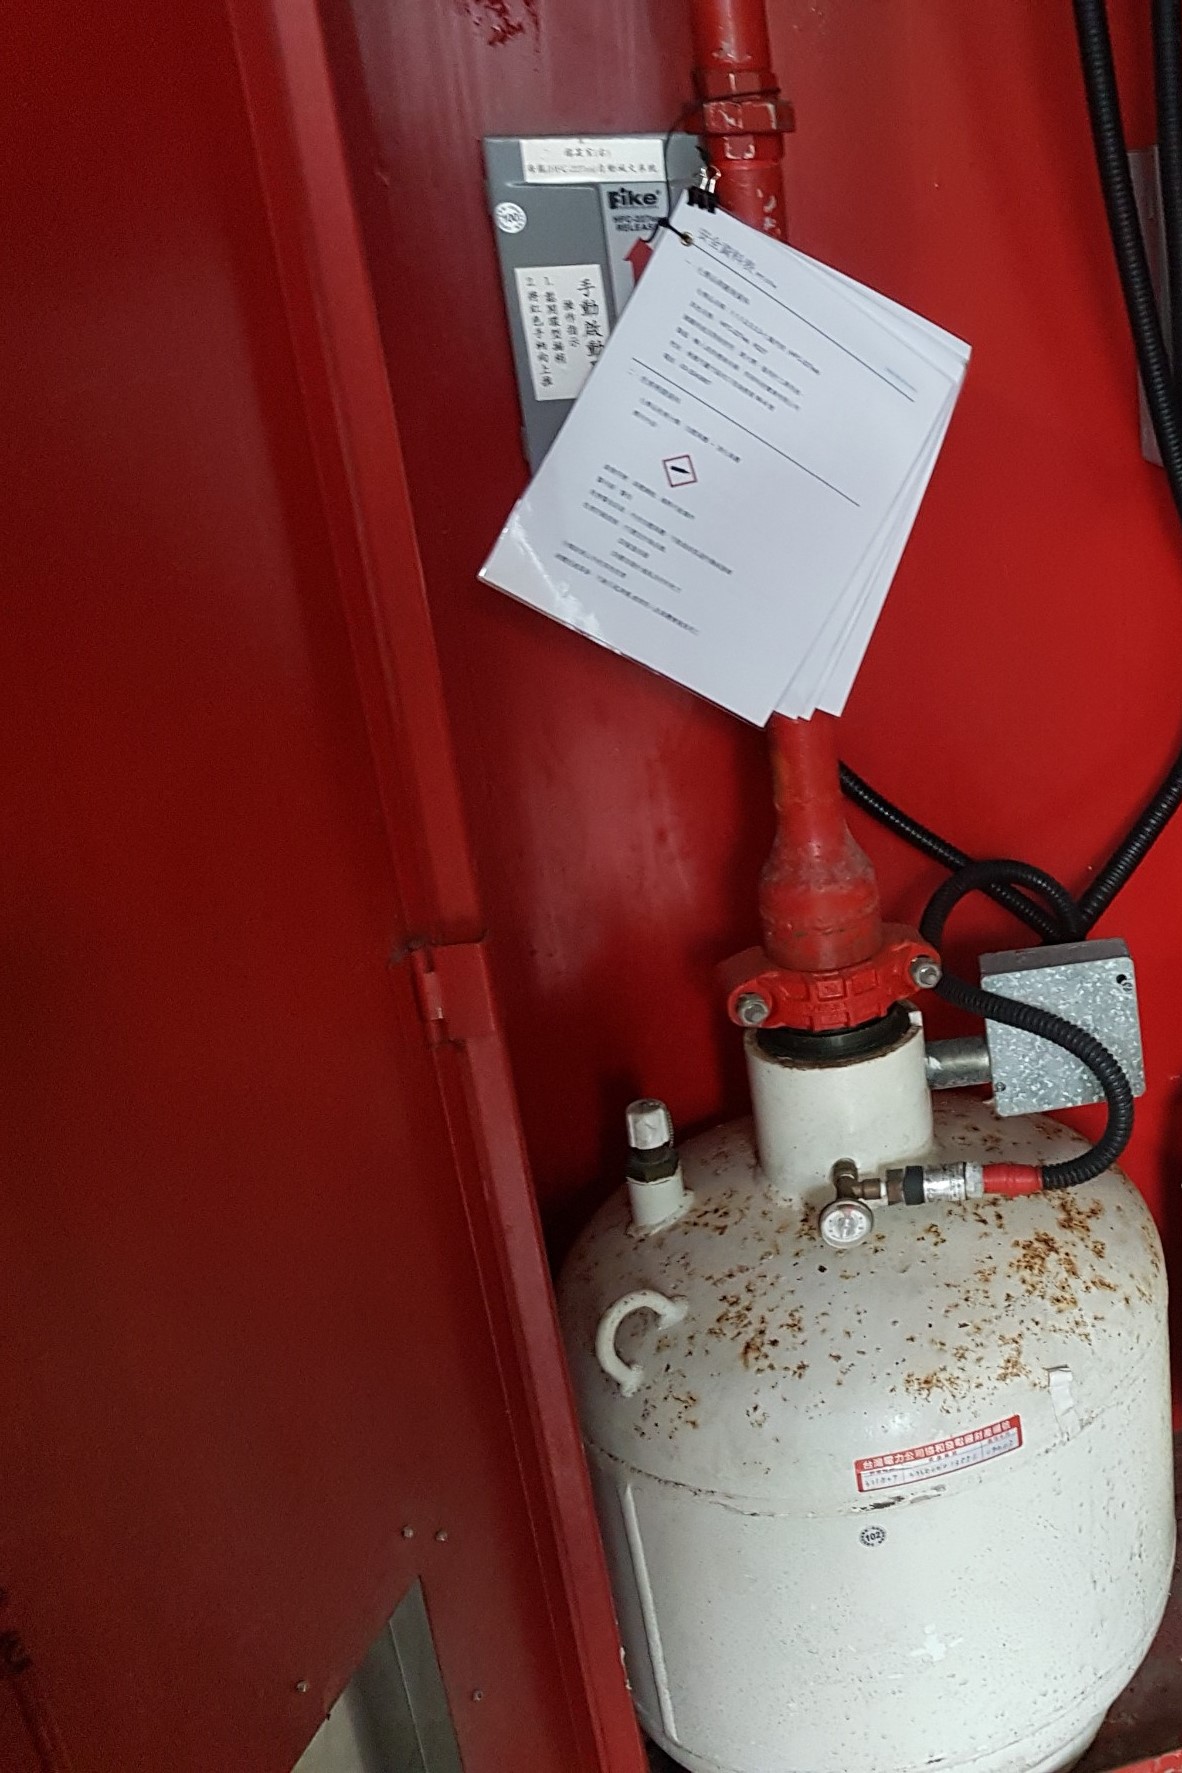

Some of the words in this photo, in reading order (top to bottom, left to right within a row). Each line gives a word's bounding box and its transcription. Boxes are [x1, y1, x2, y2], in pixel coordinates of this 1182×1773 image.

[606, 187, 658, 210] Fike
[616, 223, 656, 232] RELEAS
[577, 278, 605, 367] 手動啟動
[865, 1530, 881, 1542] 102
